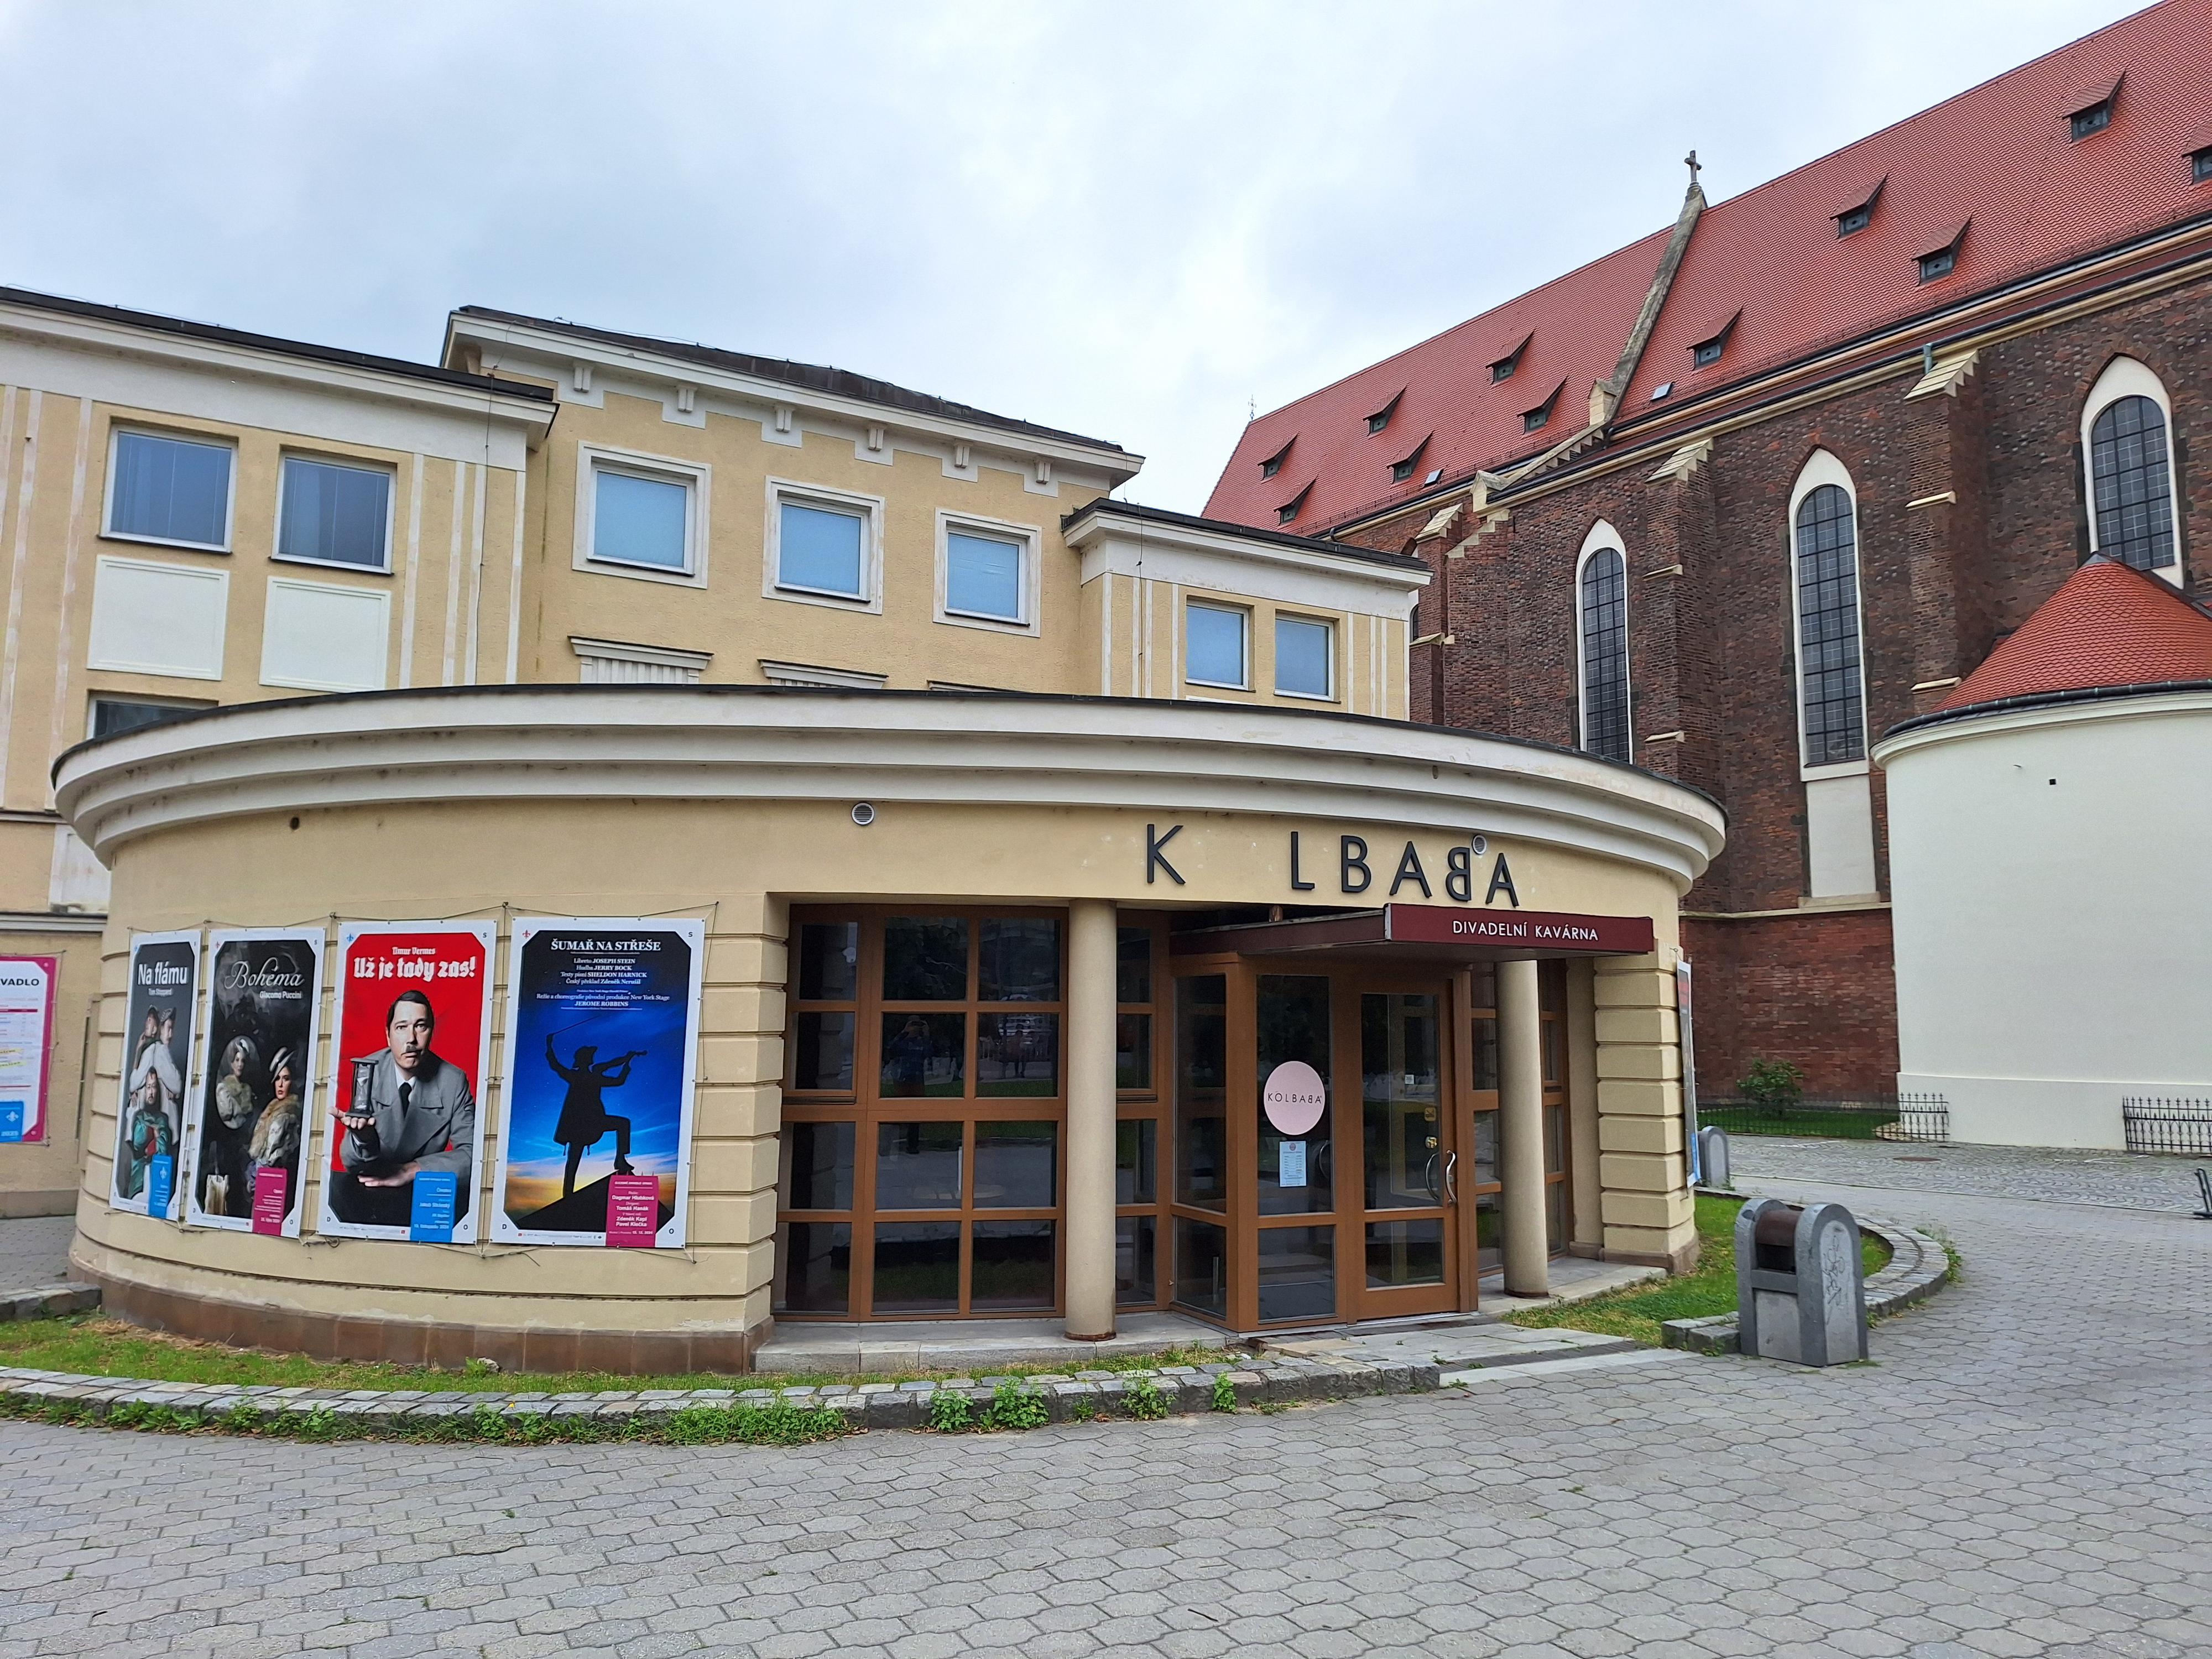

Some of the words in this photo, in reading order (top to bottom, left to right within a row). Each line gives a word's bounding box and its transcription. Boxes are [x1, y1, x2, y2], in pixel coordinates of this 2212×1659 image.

[1453, 920, 1528, 937] DIVADELNÍ
[1535, 924, 1599, 941] KAVÁRNA
[551, 938, 594, 951] ŠUMAŘ
[596, 941, 614, 951] NA
[614, 939, 661, 951] STŘEŠE
[138, 963, 153, 985] Na
[154, 961, 187, 985] flámu
[353, 957, 376, 978] Už
[378, 957, 394, 981] je
[397, 957, 435, 983] tady
[437, 956, 477, 978] zas!
[282, 991, 301, 999] Puccini
